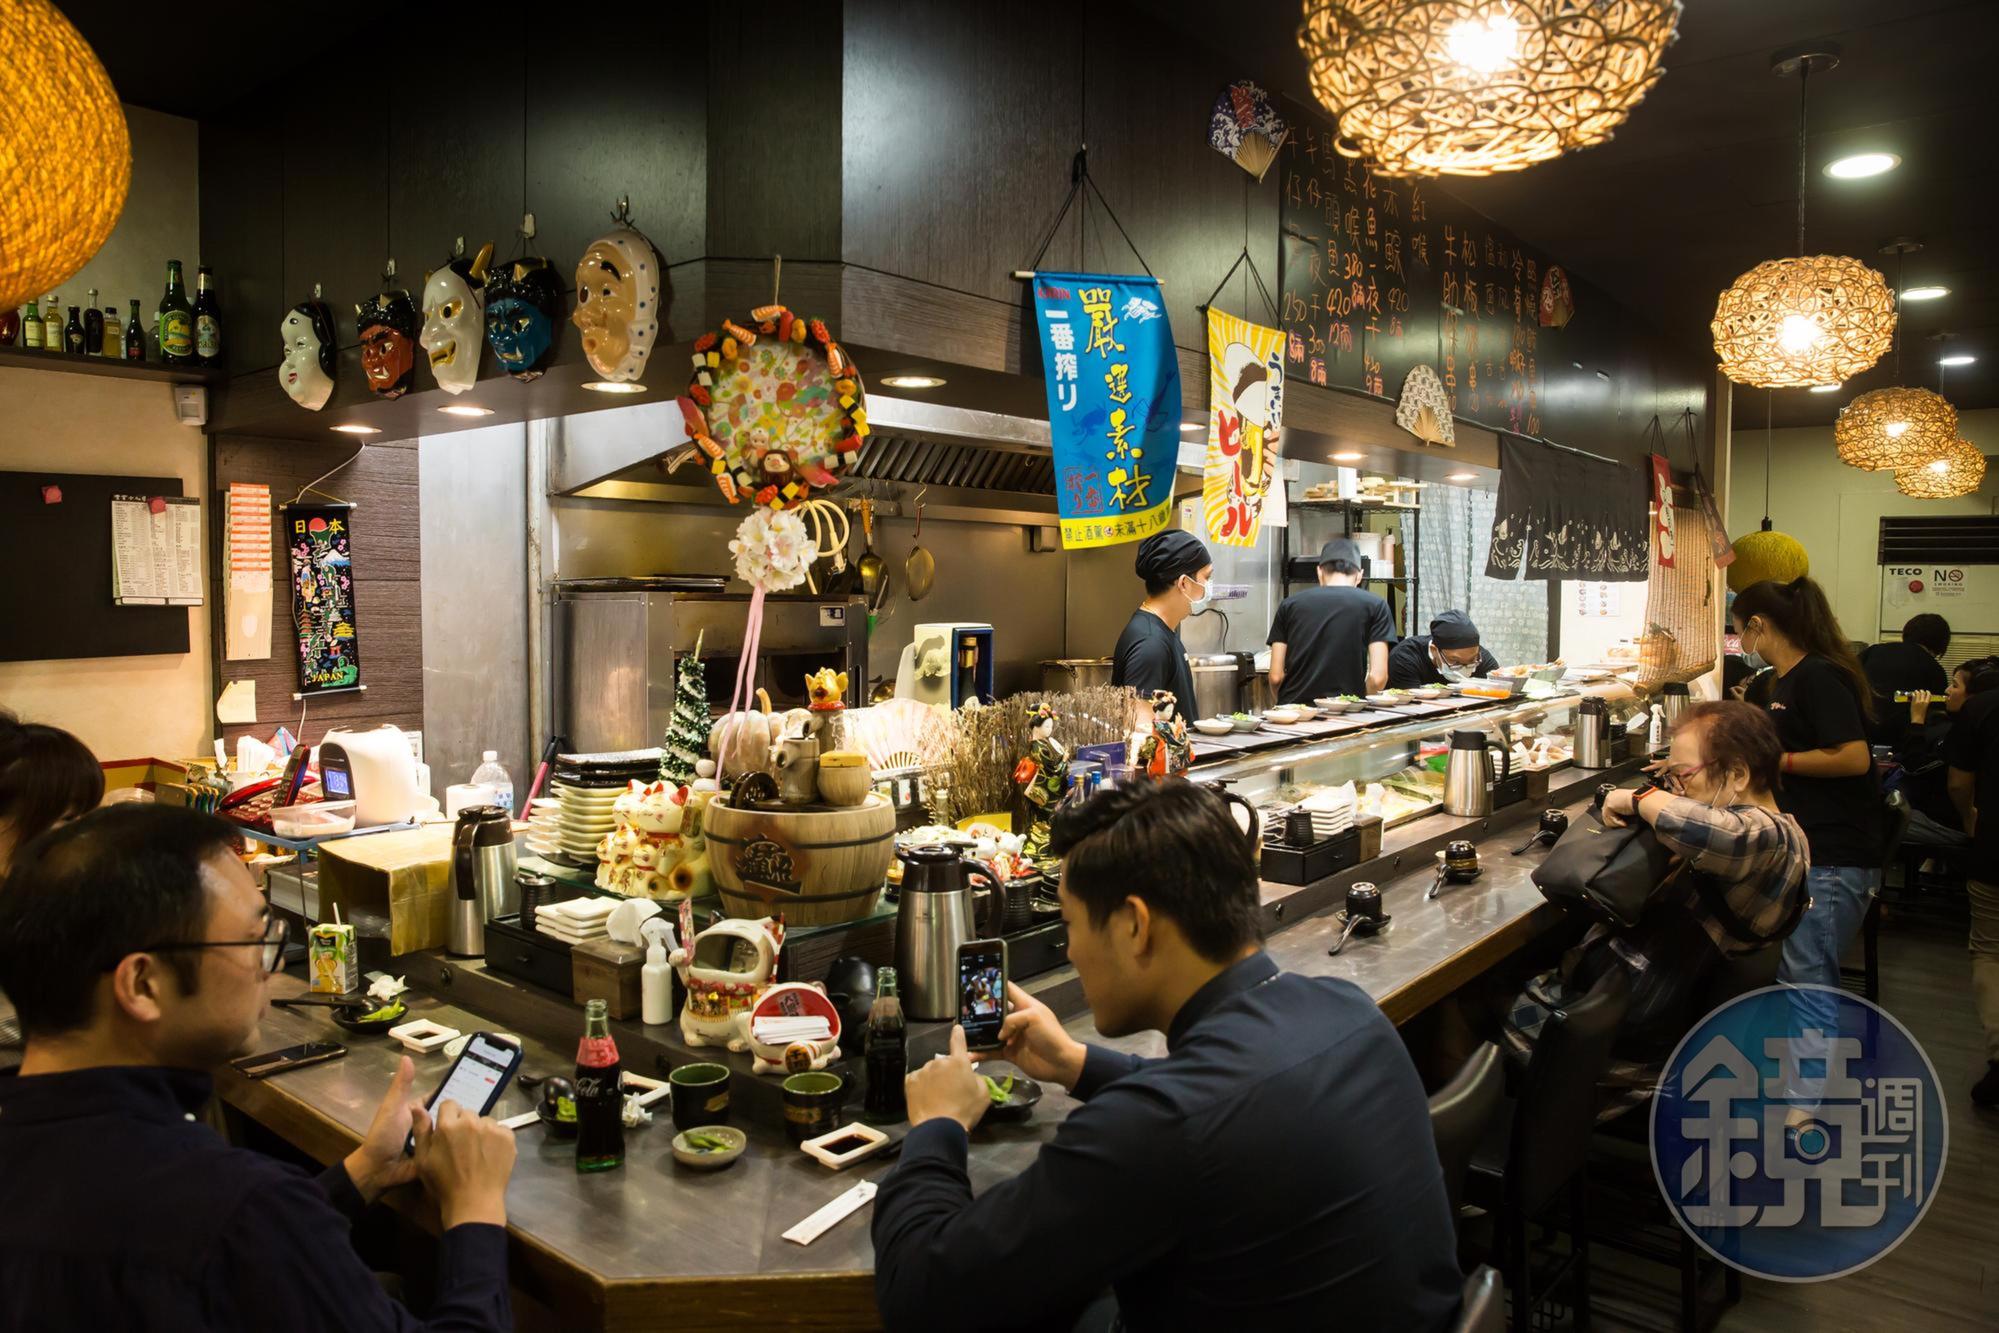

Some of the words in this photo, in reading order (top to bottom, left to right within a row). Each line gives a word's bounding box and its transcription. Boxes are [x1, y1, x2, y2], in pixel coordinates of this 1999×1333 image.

[1044, 308, 1079, 412] 一番搾り
[1889, 568, 1922, 576] TECO
[311, 671, 344, 684] JAPAN
